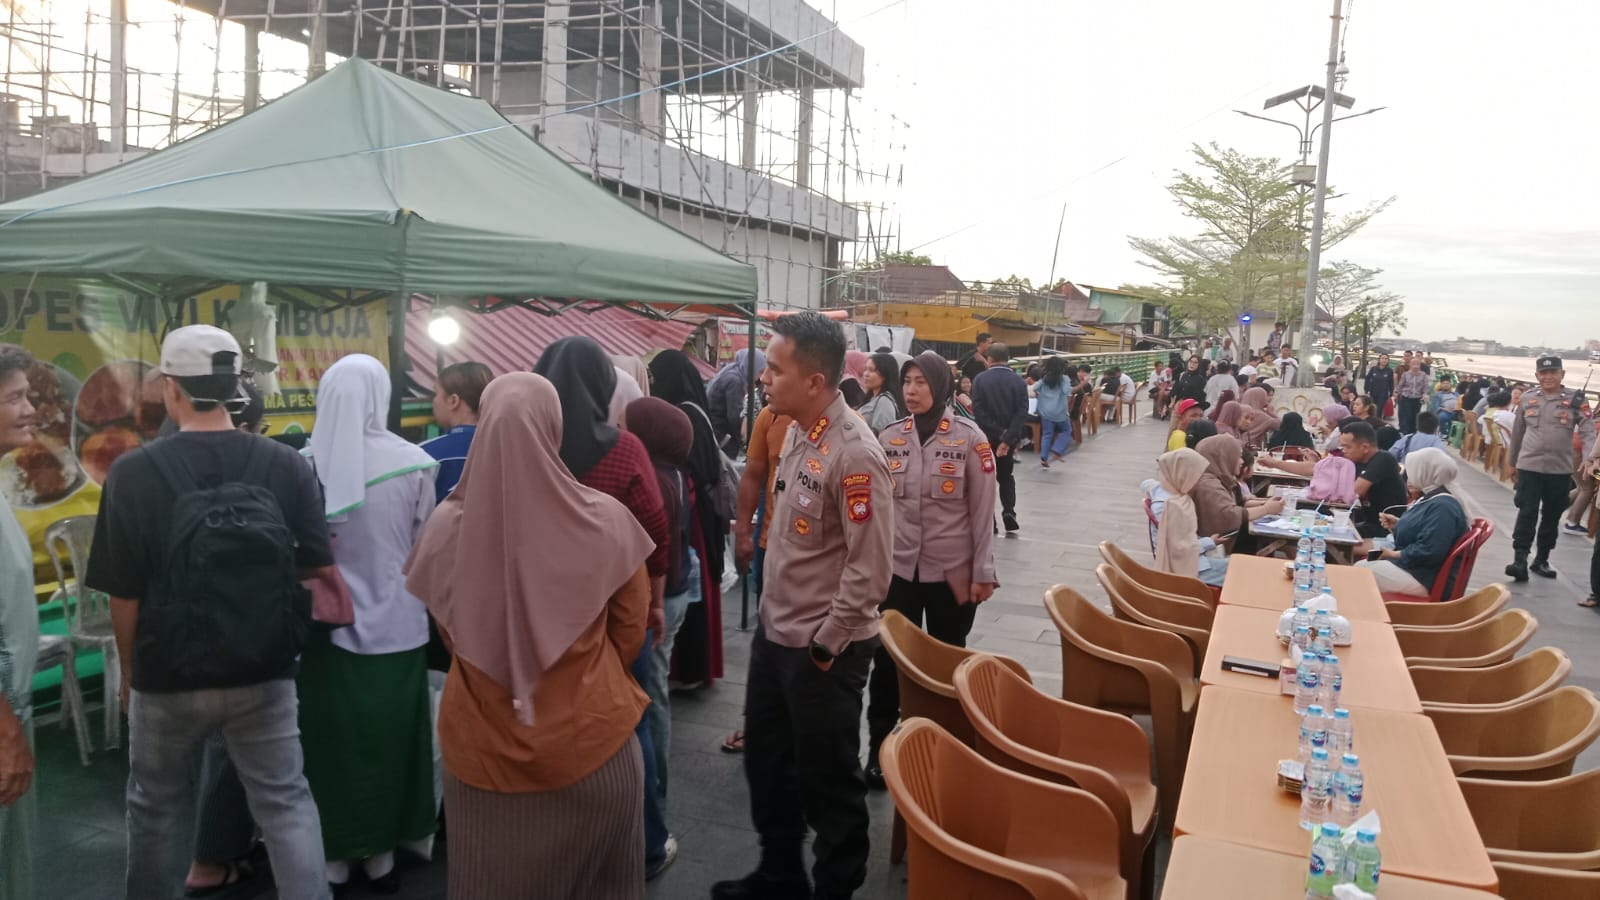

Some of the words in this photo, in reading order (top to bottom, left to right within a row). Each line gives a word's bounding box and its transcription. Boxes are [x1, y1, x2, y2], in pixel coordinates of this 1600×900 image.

[0, 287, 102, 335] PES
[213, 298, 371, 338] KMBOJA
[263, 393, 286, 409] MA
[289, 393, 316, 407] PES
[935, 451, 966, 460] POLRI
[797, 471, 822, 493] POLRI
